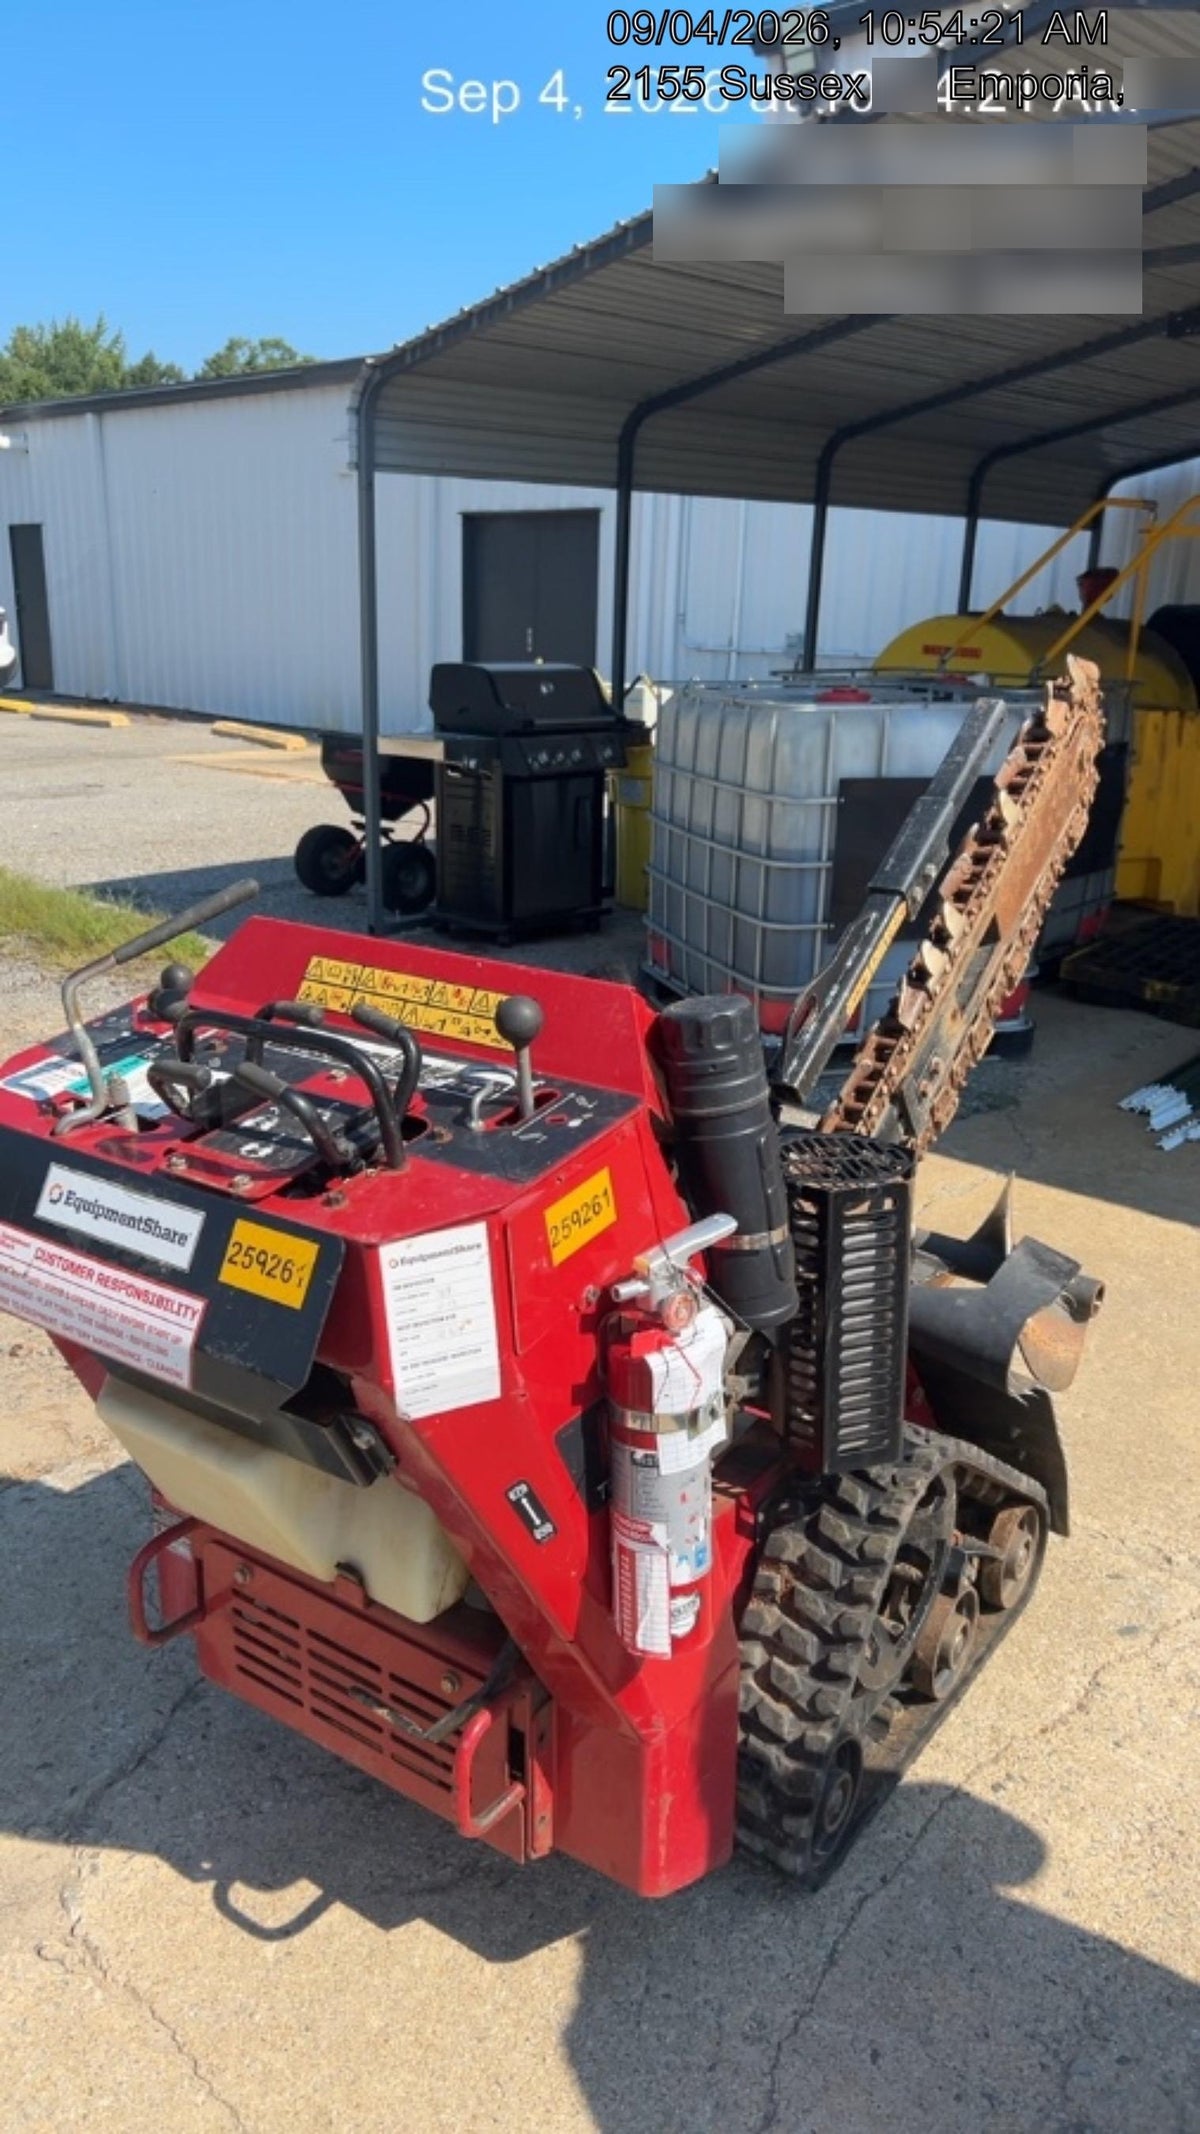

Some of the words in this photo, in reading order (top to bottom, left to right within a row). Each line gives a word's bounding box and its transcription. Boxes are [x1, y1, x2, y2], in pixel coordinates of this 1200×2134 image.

[63, 1189, 190, 1247] EquipmentShare
[550, 1187, 612, 1249] 259261
[33, 1247, 94, 1282] CUSTOMER
[97, 1272, 200, 1322] RESPONSIBILITY
